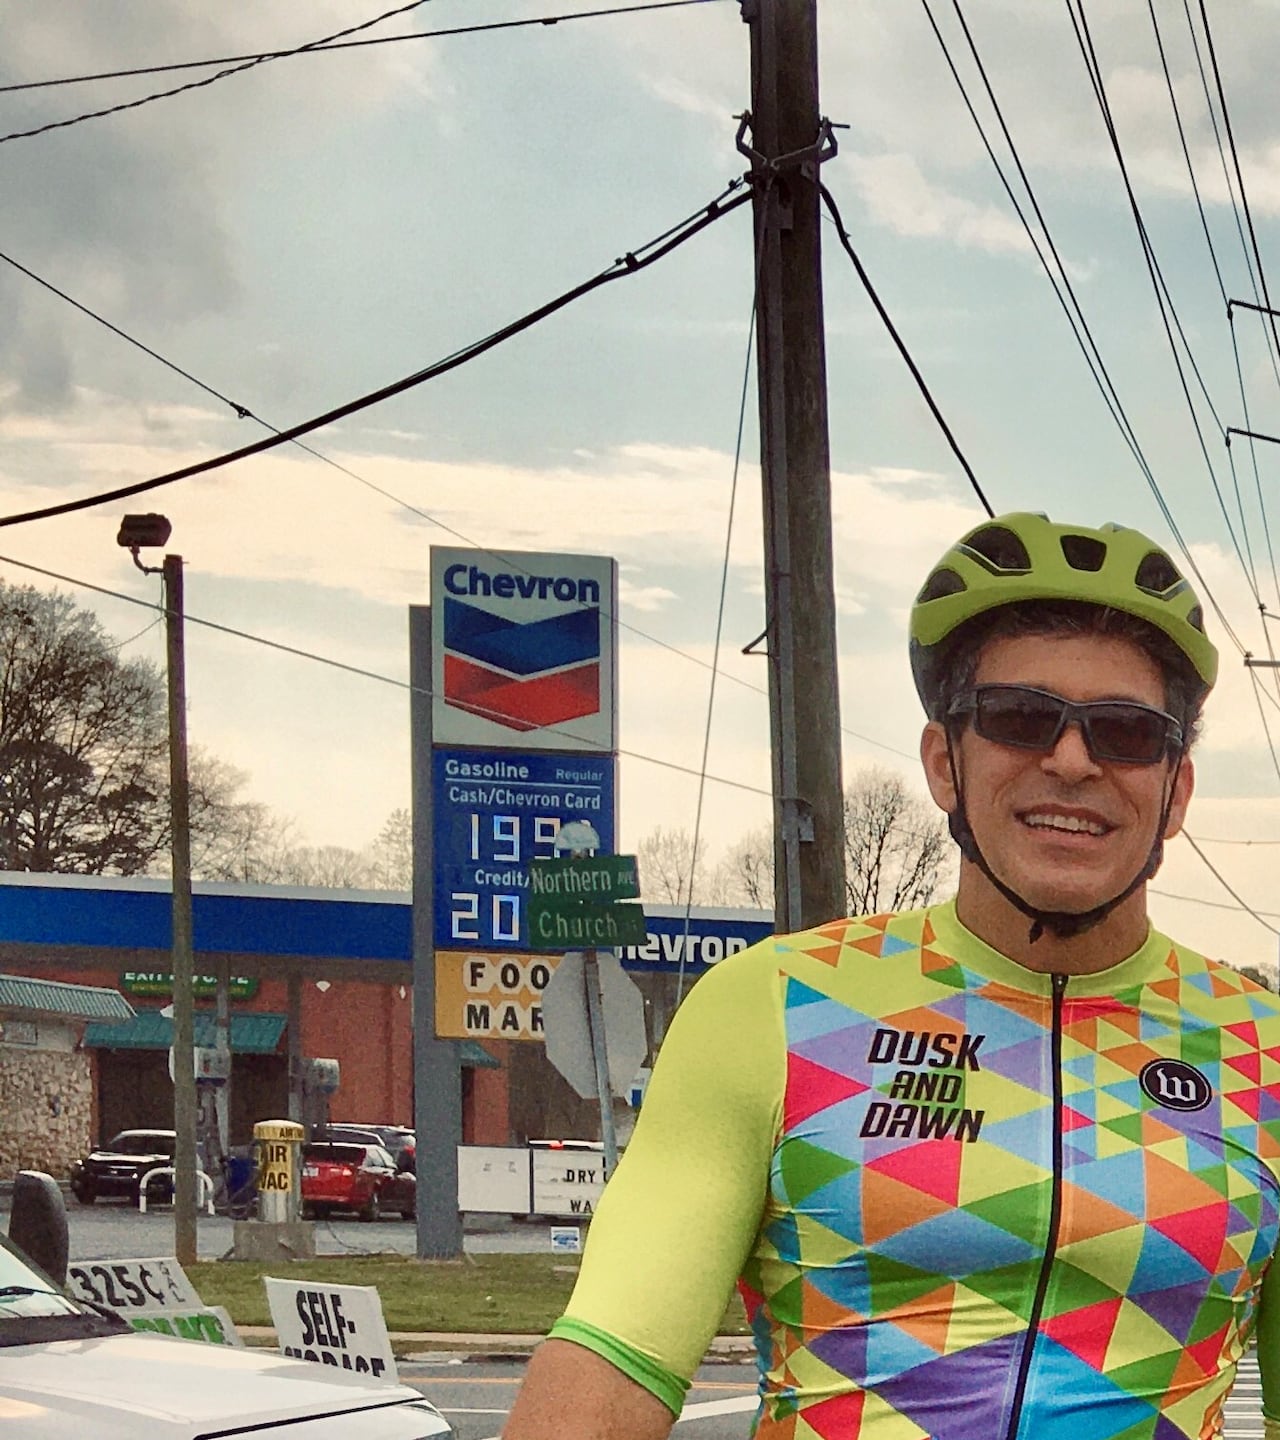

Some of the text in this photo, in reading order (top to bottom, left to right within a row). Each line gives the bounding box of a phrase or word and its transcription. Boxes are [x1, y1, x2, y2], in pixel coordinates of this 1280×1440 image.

[444, 564, 600, 603] Chevron
[445, 759, 603, 782] Gasoline Regular
[450, 786, 601, 809] Cash/Chevron Card
[532, 866, 612, 894] Northern
[539, 911, 618, 938] Church
[614, 933, 748, 964] evron
[469, 962, 550, 990] FOO
[467, 1004, 545, 1032] MAR
[867, 1028, 986, 1072] DUSK
[889, 1070, 963, 1104] AND
[858, 1101, 986, 1143] DAWN
[566, 1169, 596, 1183] DRY
[570, 1199, 593, 1214] WA
[296, 1289, 357, 1348] SELF-
